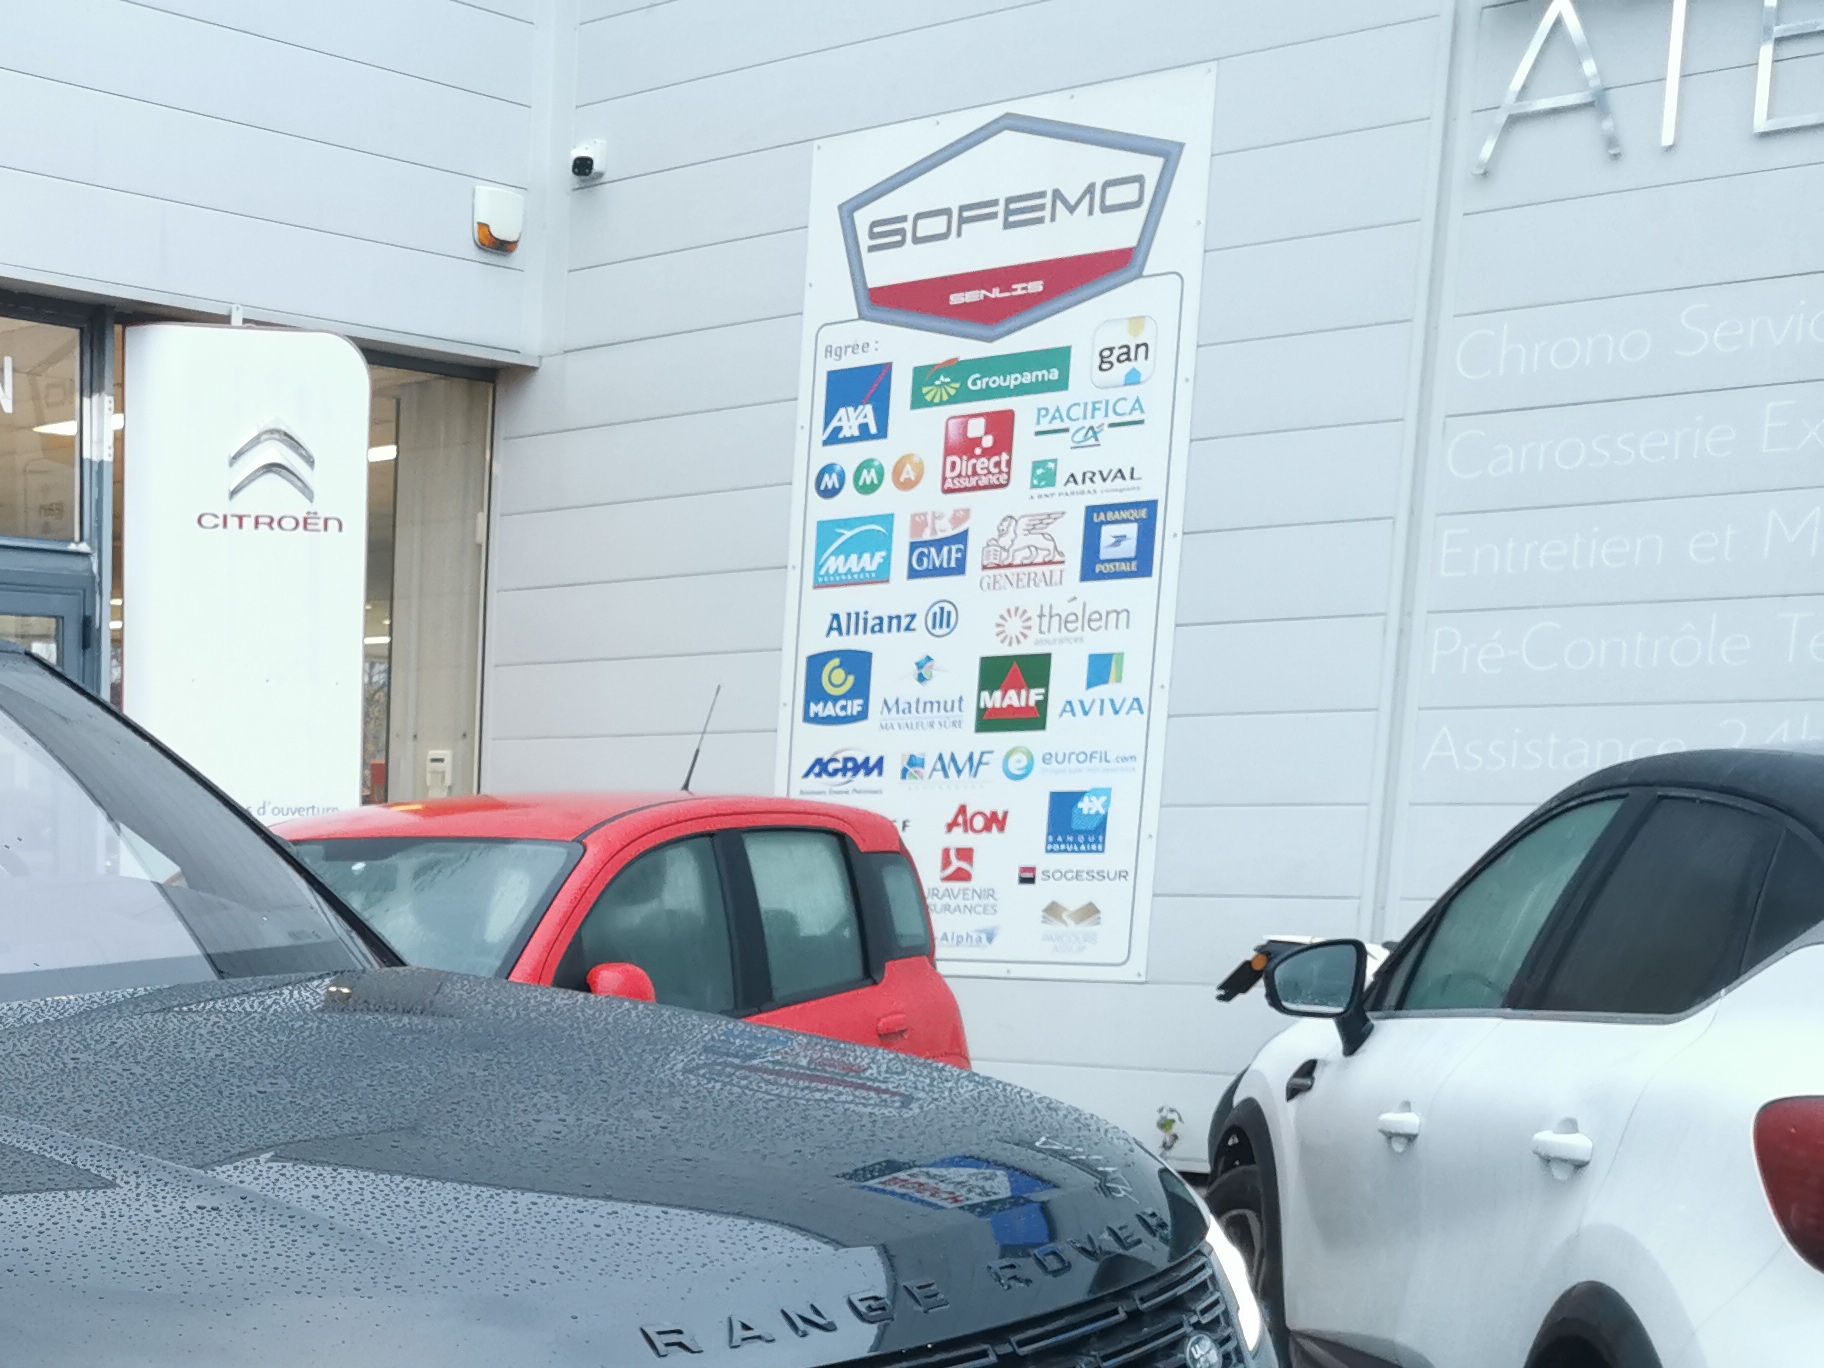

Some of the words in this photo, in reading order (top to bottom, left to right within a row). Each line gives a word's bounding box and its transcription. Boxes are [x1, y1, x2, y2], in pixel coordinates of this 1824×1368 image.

[867, 174, 1145, 253] SOFEMO
[949, 280, 1045, 306] SENLIS
[1098, 341, 1149, 372] gan
[1456, 324, 1651, 379] Chrono
[967, 366, 1059, 391] Groupama
[823, 403, 878, 439] AXA
[1036, 396, 1145, 425] PACIFICA
[1447, 416, 1736, 479] Carrosserie
[946, 452, 1009, 478] Direct
[1064, 467, 1142, 487] ARVAL
[1106, 508, 1148, 521] BANQUE
[819, 551, 887, 575] MAAF
[912, 544, 964, 570] GMF
[1440, 527, 1663, 577] Entretien
[1688, 524, 1736, 563] et
[1095, 561, 1138, 573] POSTALE
[979, 569, 1064, 592] GENERALI
[826, 611, 917, 637] Allianz
[1431, 612, 1752, 675] Pré-Contrôle
[809, 699, 864, 717] MACIF
[880, 695, 964, 715] Matmut
[979, 687, 1046, 709] MAIF
[1059, 697, 1144, 718] AVIVA
[802, 755, 884, 779] AGPM
[928, 751, 995, 780] AMF
[946, 804, 1009, 834] AON
[1046, 843, 1104, 852] POPULAIRE
[1047, 834, 1104, 843] BANQUE
[1041, 869, 1129, 882] SOGESSUR
[639, 1278, 950, 1359] RANGE
[987, 1208, 1174, 1290] ROVER
